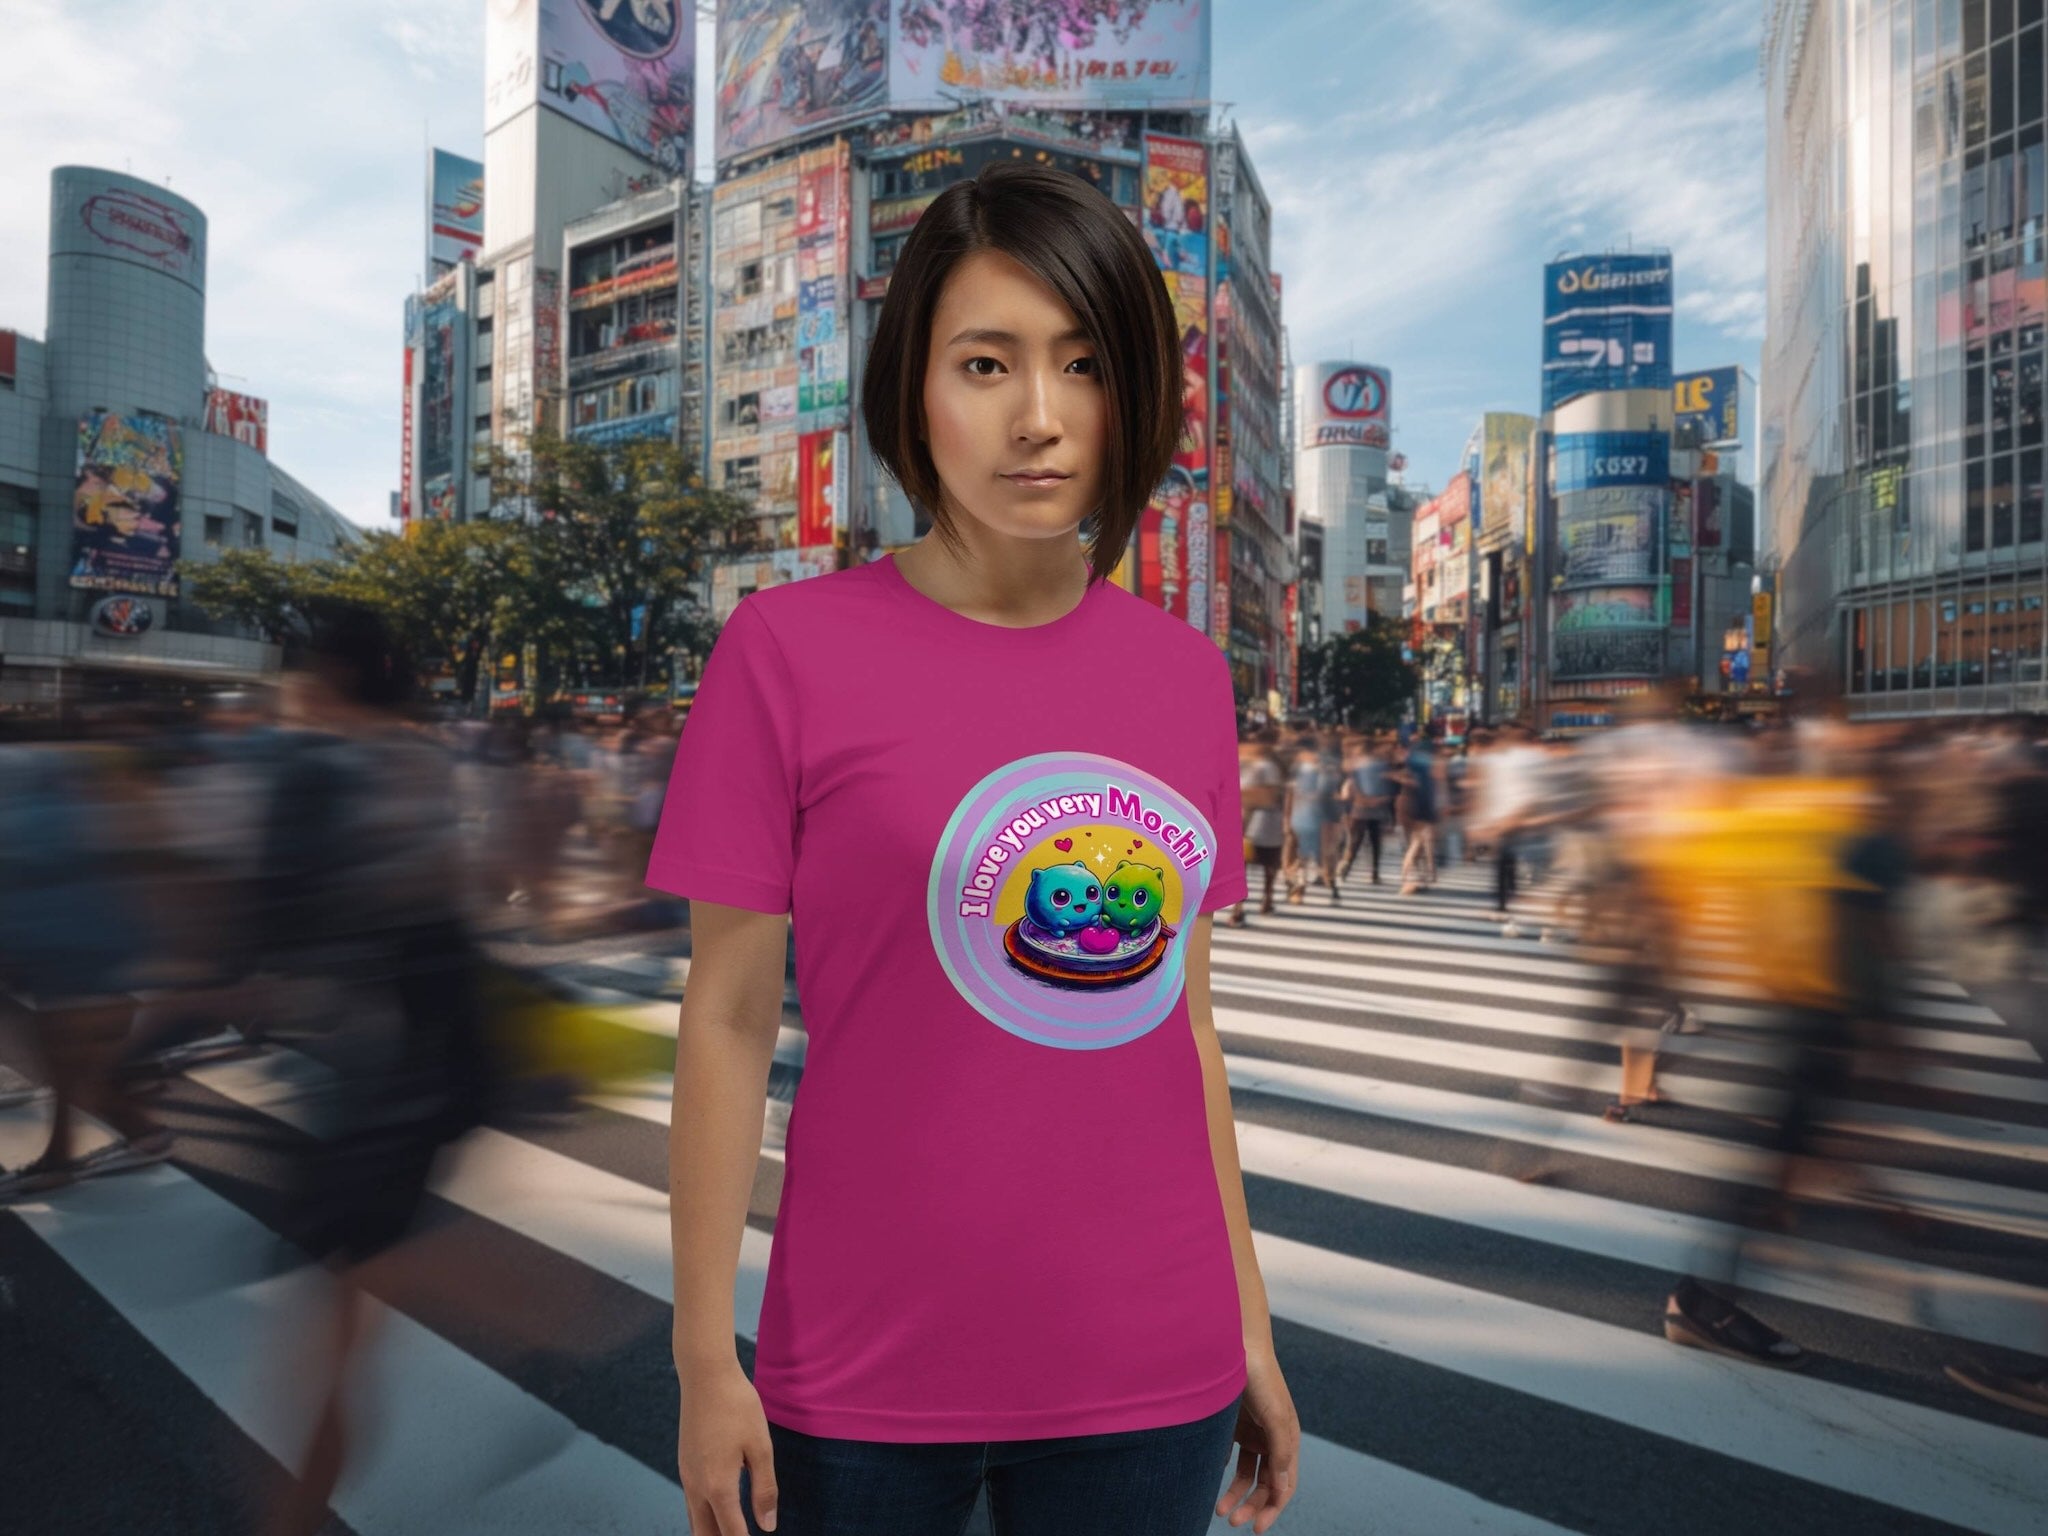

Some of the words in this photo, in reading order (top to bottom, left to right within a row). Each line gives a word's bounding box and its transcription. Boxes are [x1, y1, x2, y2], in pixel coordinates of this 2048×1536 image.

[1041, 793, 1102, 818] very
[999, 808, 1046, 851] you
[1106, 784, 1208, 871] Mochi
[964, 844, 1010, 899] love
[960, 901, 989, 917] I
